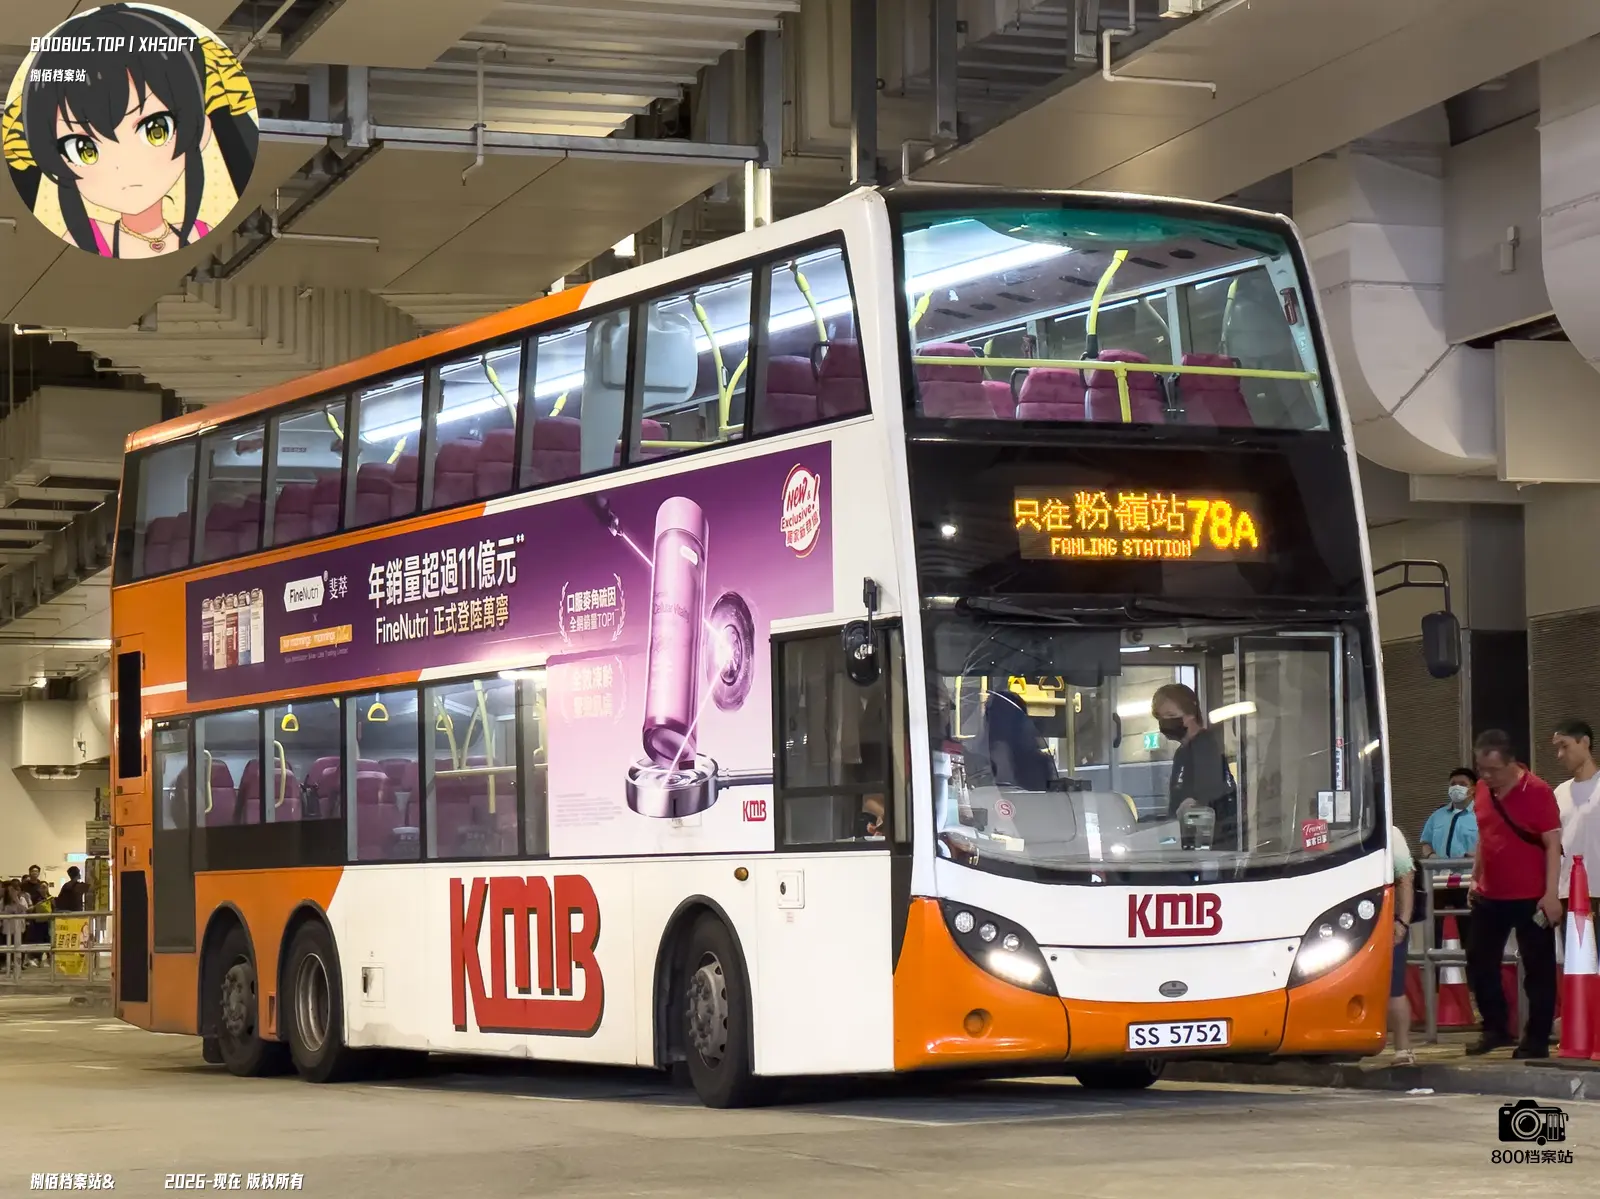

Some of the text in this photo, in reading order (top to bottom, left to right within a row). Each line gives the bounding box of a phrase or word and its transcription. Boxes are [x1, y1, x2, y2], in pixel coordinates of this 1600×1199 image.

[1186, 499, 1258, 549] 78A
[1051, 537, 1193, 557] FANLING STATION
[375, 608, 430, 644] FineNutri
[433, 593, 509, 636] 正式登陸萬寧
[1134, 1023, 1222, 1046] SS 5752
